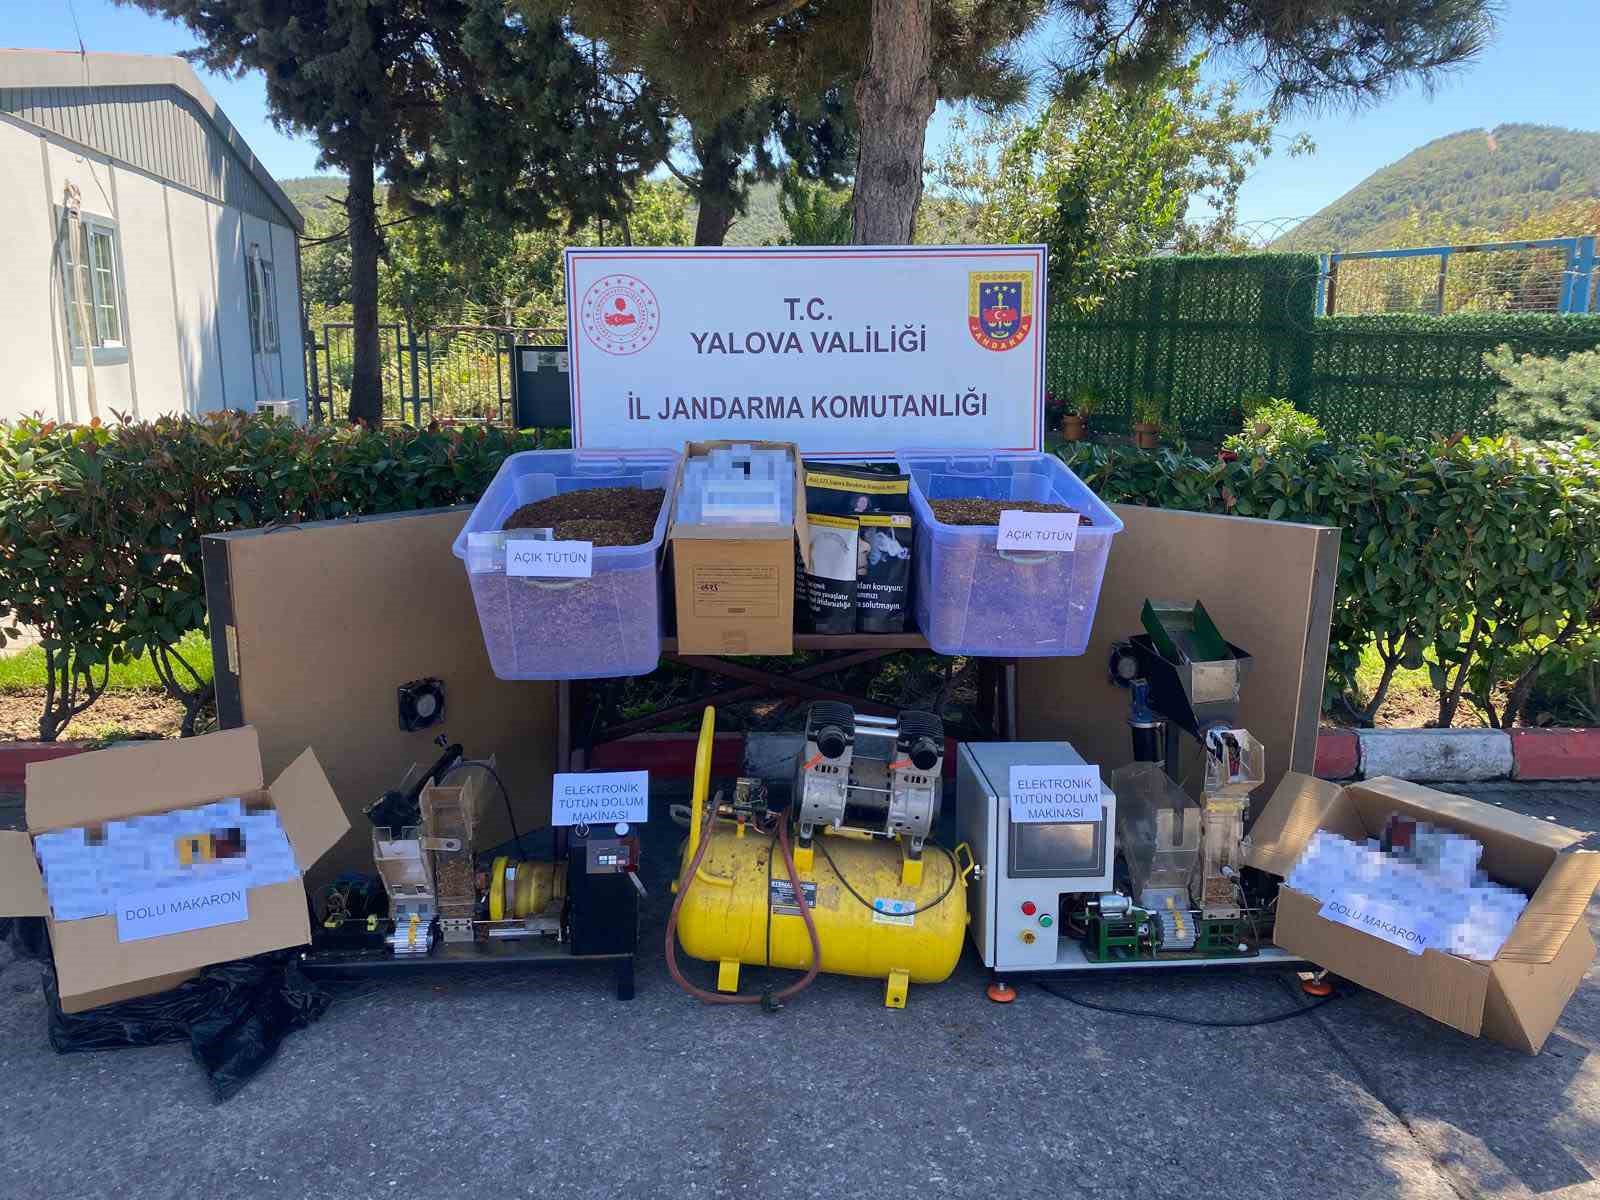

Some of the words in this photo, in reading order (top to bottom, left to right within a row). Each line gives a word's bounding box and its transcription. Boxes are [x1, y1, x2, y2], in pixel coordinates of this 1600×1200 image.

[784, 297, 833, 321] T.C.
[690, 331, 804, 354] YALOVA
[811, 324, 926, 353] VALİLİĞİ
[970, 322, 1030, 350] JANDARMA
[628, 391, 650, 420] İL
[657, 396, 804, 420] JANDARMA
[811, 386, 988, 419] KOMUTANLIĞI
[1006, 529, 1032, 542] AÇIK
[514, 552, 543, 564] AÇIK
[545, 551, 587, 563] TÜTÜN
[601, 796, 644, 807] DOLUM
[1055, 792, 1099, 804] DOLUM
[126, 903, 166, 921] DOLU
[170, 891, 241, 913] MAKARON
[1328, 901, 1361, 920] DOLU
[1363, 915, 1426, 944] MAKARON
